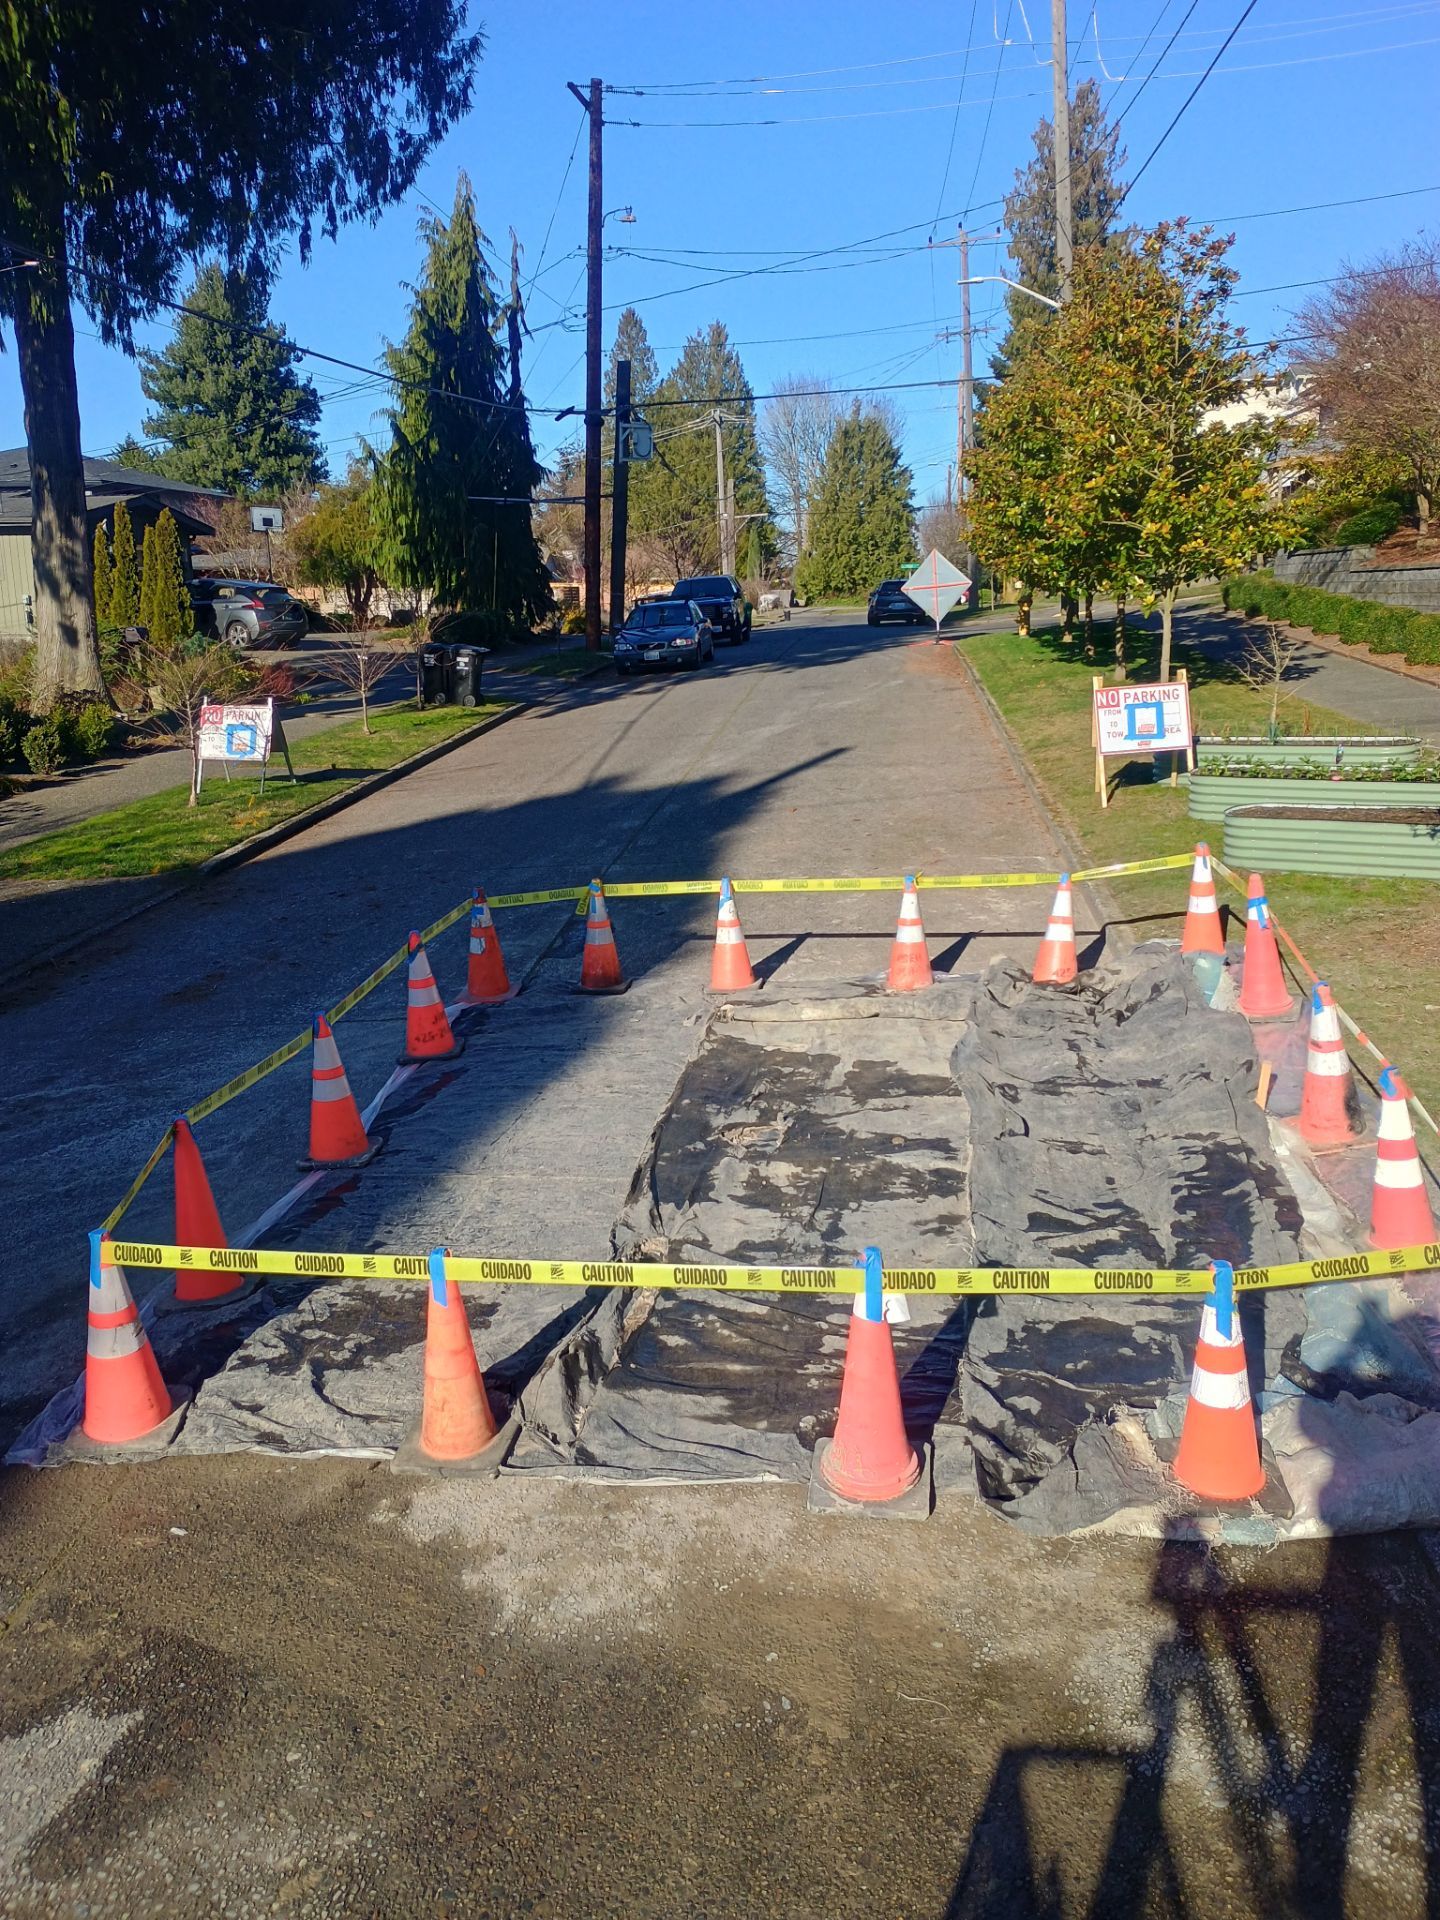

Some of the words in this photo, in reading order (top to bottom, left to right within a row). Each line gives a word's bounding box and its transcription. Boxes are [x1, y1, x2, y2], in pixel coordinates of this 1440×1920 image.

[1097, 690, 1118, 706] NO
[1124, 689, 1180, 703] PARKING
[225, 710, 267, 721] PARKING
[1164, 726, 1181, 734] REA
[114, 1244, 162, 1265] CUIDADO
[210, 1250, 258, 1269] CAUTION
[295, 1254, 345, 1273] CUIDADO
[394, 1258, 430, 1275] CAUTI
[481, 1261, 532, 1280] CUIDADO
[582, 1264, 634, 1283] CAUTION
[674, 1267, 727, 1286] CUIDADO
[781, 1269, 836, 1288] CAUTION
[882, 1271, 936, 1290] CUIDADO
[993, 1270, 1050, 1289] CAUTION
[1094, 1271, 1153, 1290] CUIDADO
[1213, 1269, 1269, 1286] UTION
[1311, 1255, 1369, 1279] CUIDADO
